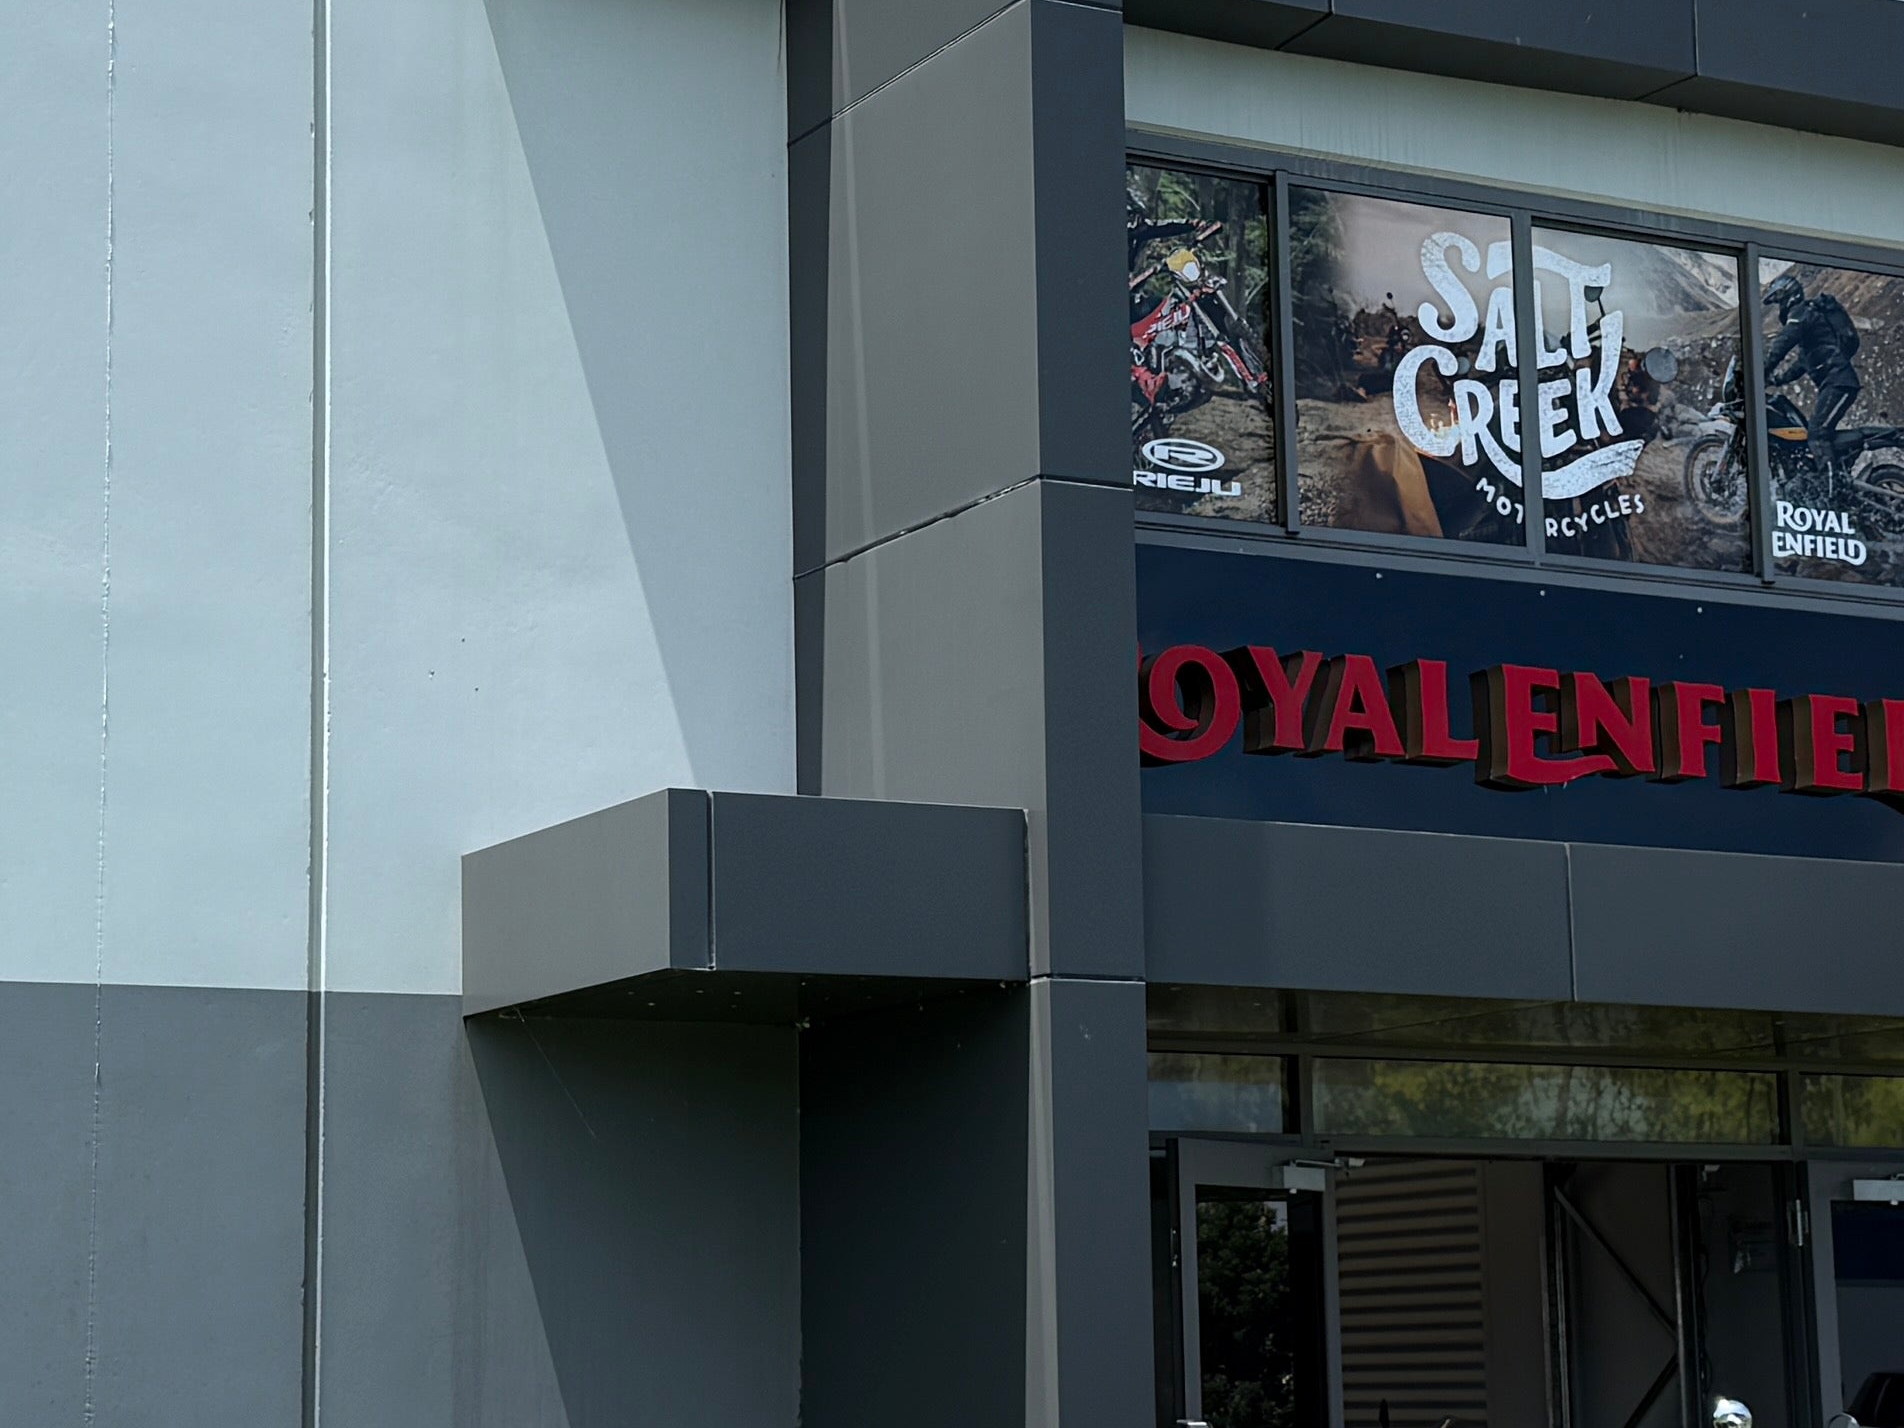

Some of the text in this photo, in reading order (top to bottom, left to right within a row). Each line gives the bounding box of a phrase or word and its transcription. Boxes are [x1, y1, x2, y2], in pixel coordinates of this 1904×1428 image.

[1417, 231, 1612, 372] SALT
[1392, 310, 1645, 501] CREEK
[1132, 470, 1242, 497] RIEJU
[1475, 476, 1645, 539] MOTRCYCLES
[1771, 530, 1867, 566] ENFIELD
[1776, 500, 1856, 534] ROYAL
[1138, 641, 1480, 762] OYAL
